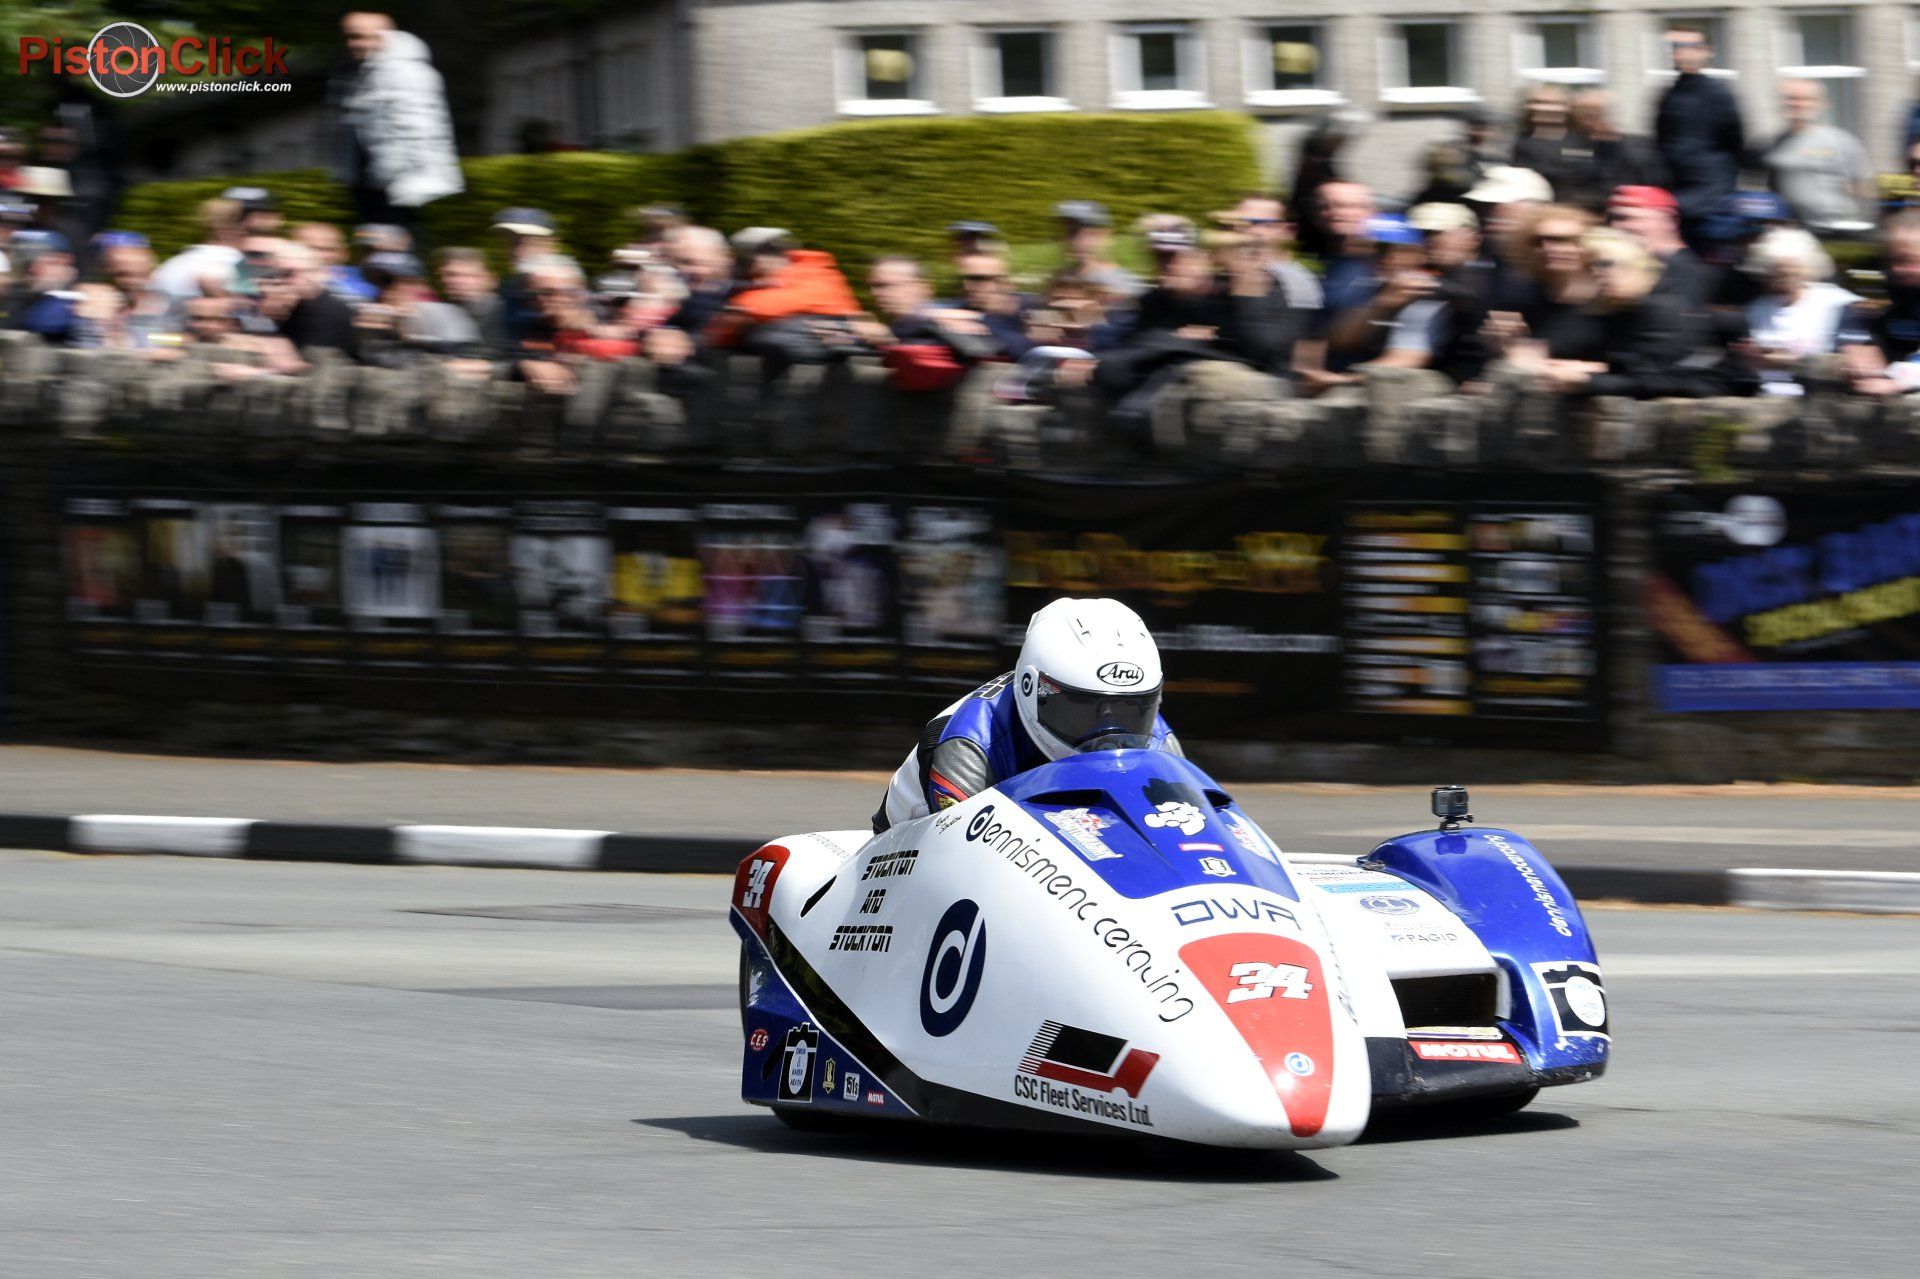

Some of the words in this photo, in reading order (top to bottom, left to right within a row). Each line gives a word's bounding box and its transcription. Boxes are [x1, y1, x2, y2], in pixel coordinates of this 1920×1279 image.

[1100, 663, 1140, 680] Arai
[861, 850, 919, 881] STOCKTON
[742, 859, 775, 909] 34
[860, 889, 886, 914] AND
[829, 925, 893, 952] STOCKTON
[1226, 962, 1314, 1004] 34
[1419, 1043, 1515, 1060] MOTUL
[1014, 1074, 1038, 1101] CSC
[1041, 1081, 1070, 1109] Fleet
[1072, 1088, 1126, 1122] Services
[1128, 1101, 1154, 1127] Ltd.
